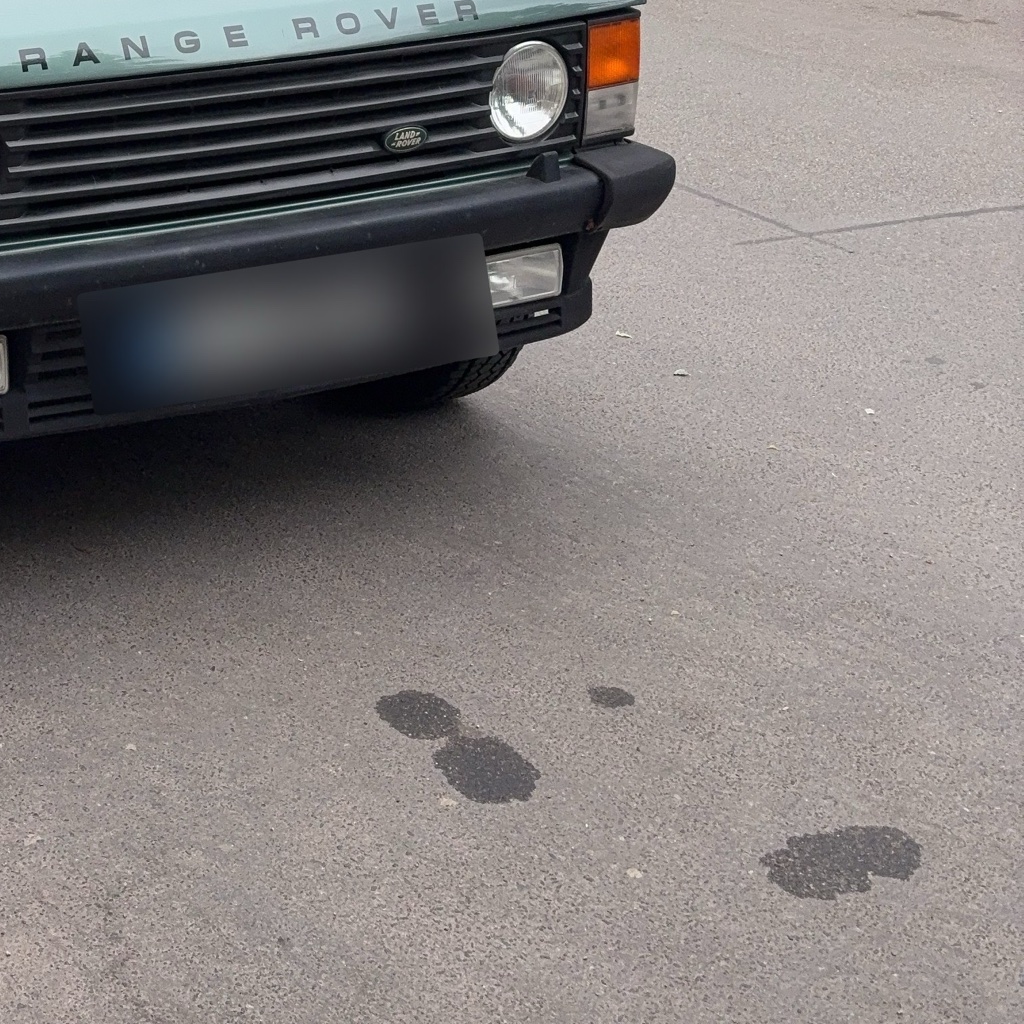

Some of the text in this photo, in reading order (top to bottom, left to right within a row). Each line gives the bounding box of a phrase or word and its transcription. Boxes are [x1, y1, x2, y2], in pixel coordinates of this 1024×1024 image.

[17, 0, 480, 74] RANGE ROVER
[394, 130, 416, 141] LAND
[395, 136, 422, 148] ROVER
